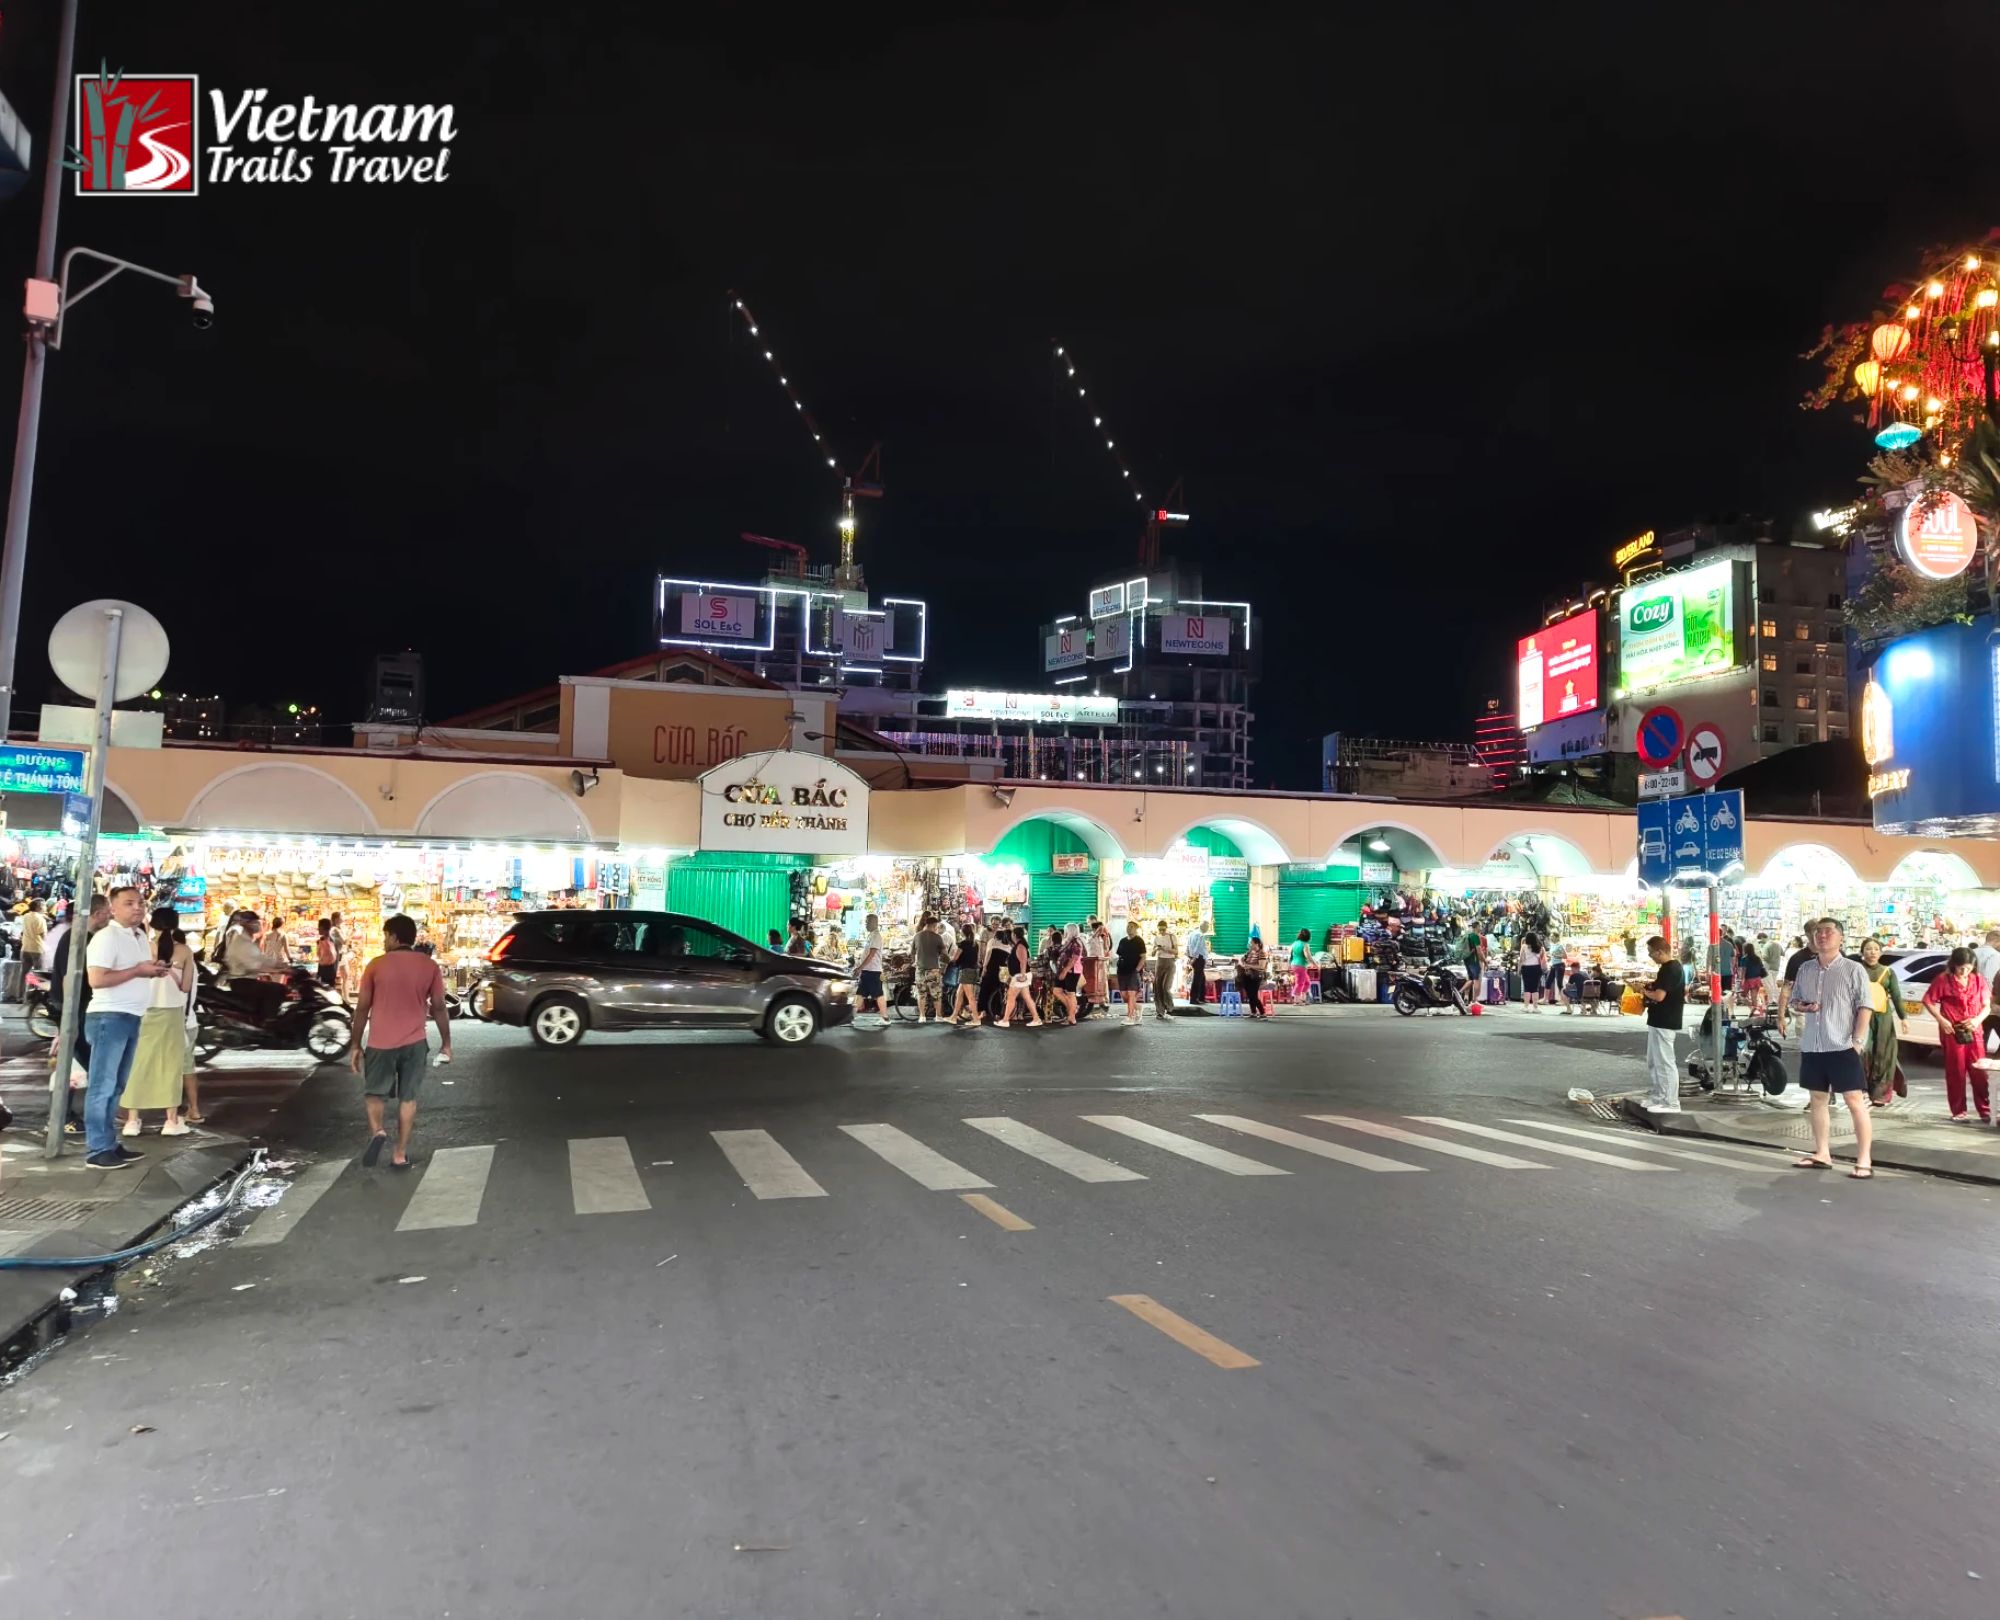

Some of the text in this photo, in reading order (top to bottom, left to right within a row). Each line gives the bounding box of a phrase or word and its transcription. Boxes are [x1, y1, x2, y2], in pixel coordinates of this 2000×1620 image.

[1616, 531, 1655, 564] SILVERLAND
[1633, 600, 1670, 625] Cozy
[694, 618, 717, 632] SOL
[719, 620, 742, 633] E&C
[1165, 638, 1224, 650] NEWTECONS
[1047, 652, 1084, 666] NEWTECONS
[1040, 711, 1054, 719] SOL
[1076, 710, 1117, 718] ARTELIA
[15, 770, 54, 788] THÁNH
[723, 776, 849, 808] CỬA BẮC
[723, 809, 848, 832] CHỢ BẾN THÀNH
[1182, 854, 1206, 864] NGA
